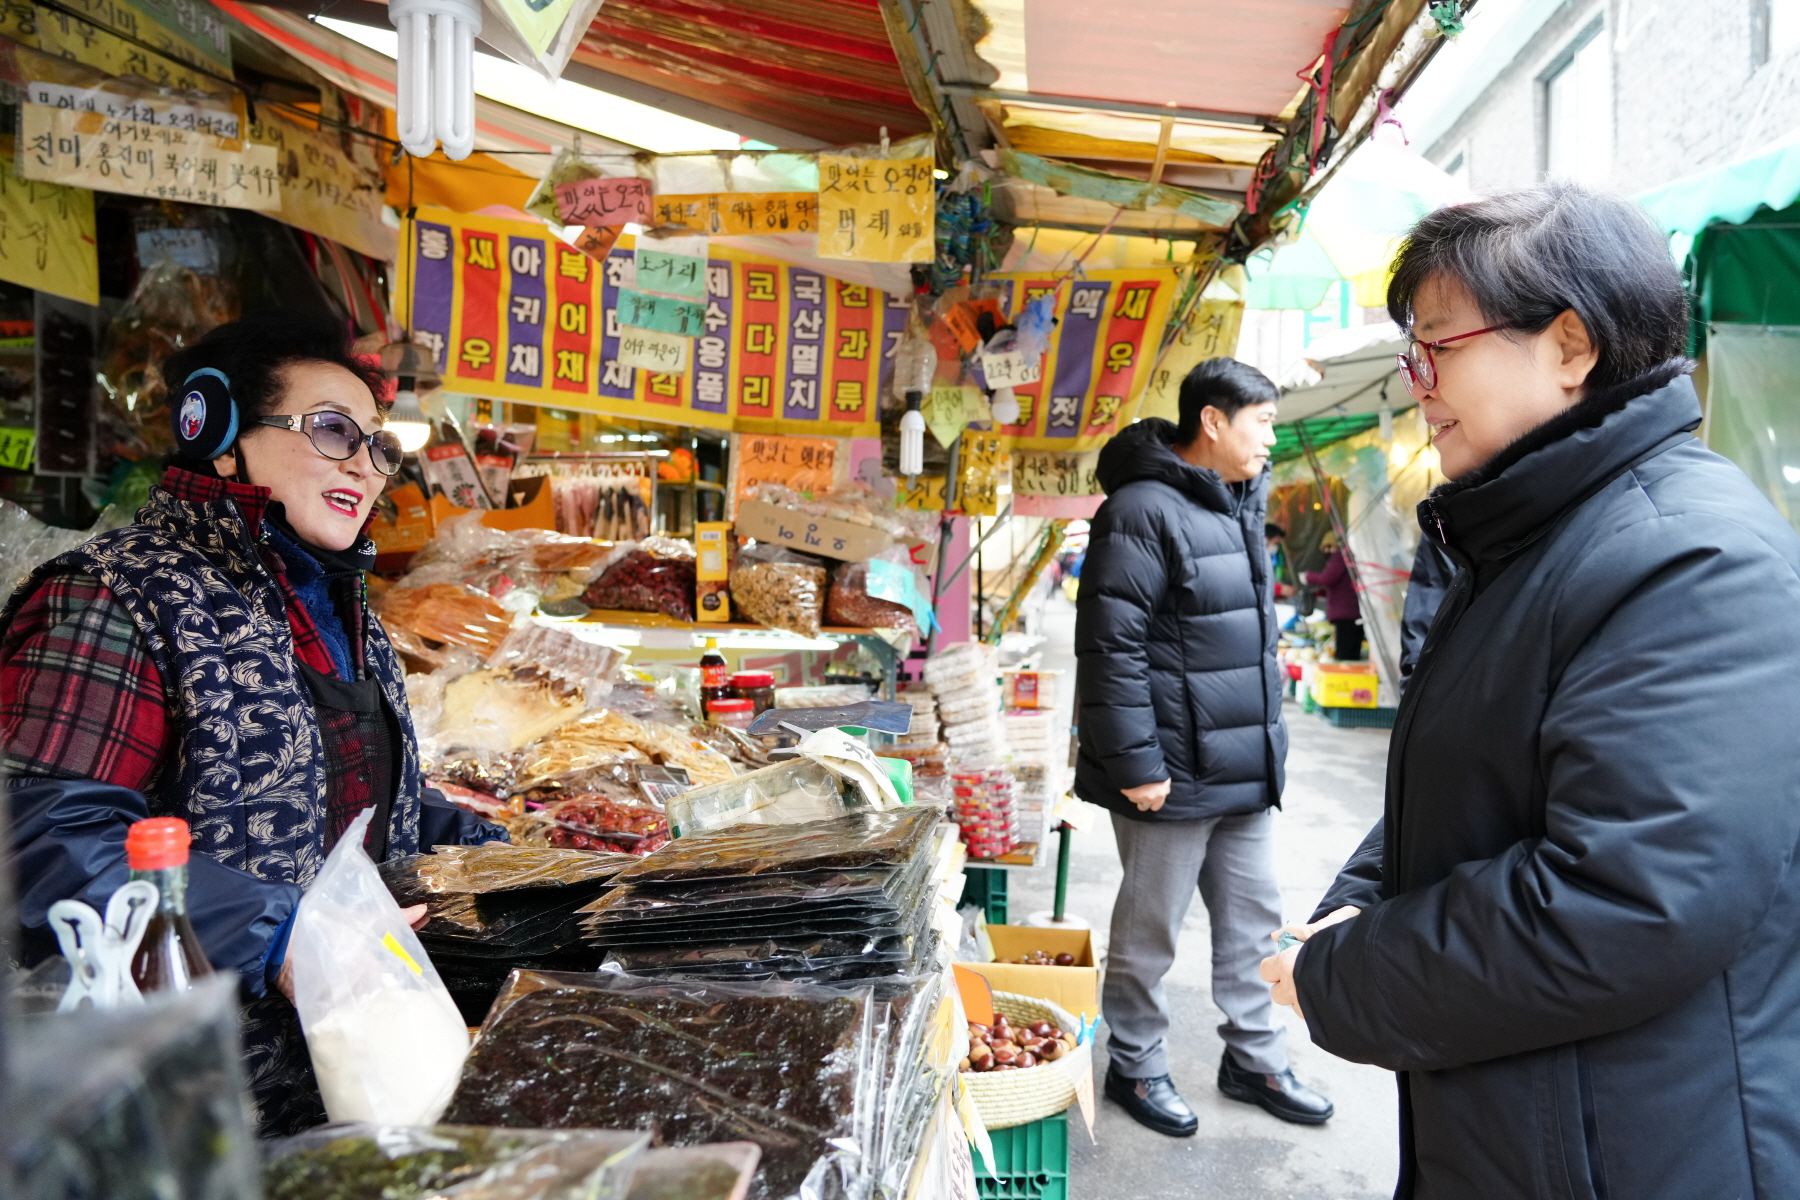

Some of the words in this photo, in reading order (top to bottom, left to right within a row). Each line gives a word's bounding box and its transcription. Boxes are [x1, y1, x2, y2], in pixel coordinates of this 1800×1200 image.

[820, 164, 877, 194] 맛있는
[883, 163, 933, 195] 오징어
[461, 237, 497, 370] 새우
[509, 244, 543, 379] 아귀채
[556, 250, 589, 384] 북어채
[696, 267, 729, 404] 제수용품
[742, 271, 776, 408] 코다리
[787, 274, 824, 411] 국산멸치
[834, 280, 870, 412] 견과류
[1049, 287, 1104, 428] 액젓
[1089, 287, 1155, 427] 새우젓
